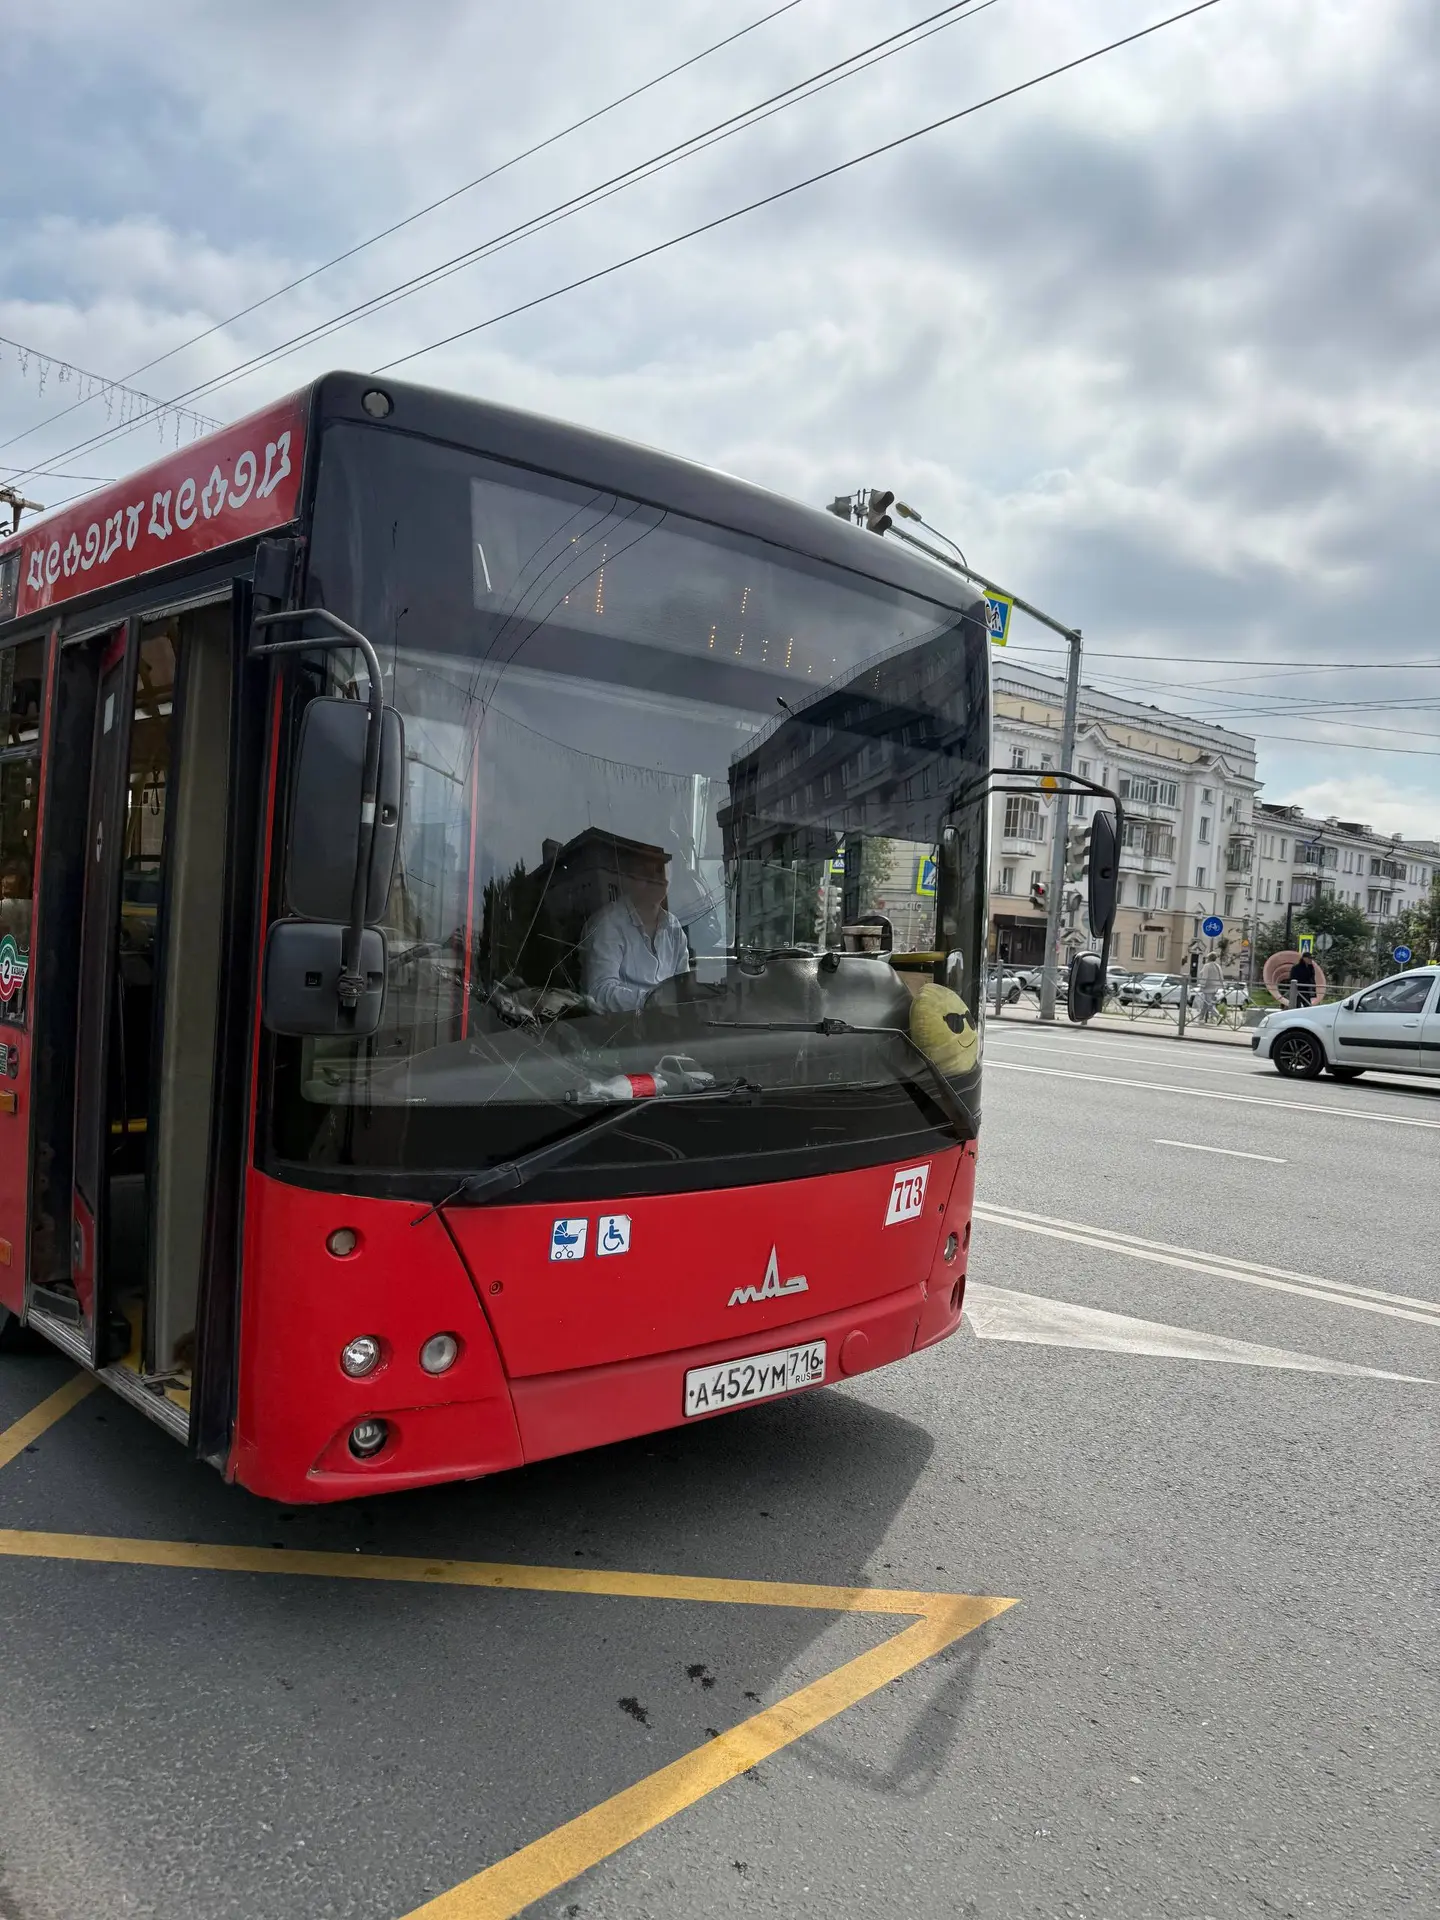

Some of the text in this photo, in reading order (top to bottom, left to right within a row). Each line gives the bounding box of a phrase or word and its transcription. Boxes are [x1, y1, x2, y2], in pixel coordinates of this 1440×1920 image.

[894, 1176, 923, 1212] 773
[790, 1348, 820, 1376] 716
[795, 1372, 811, 1384] RUS
